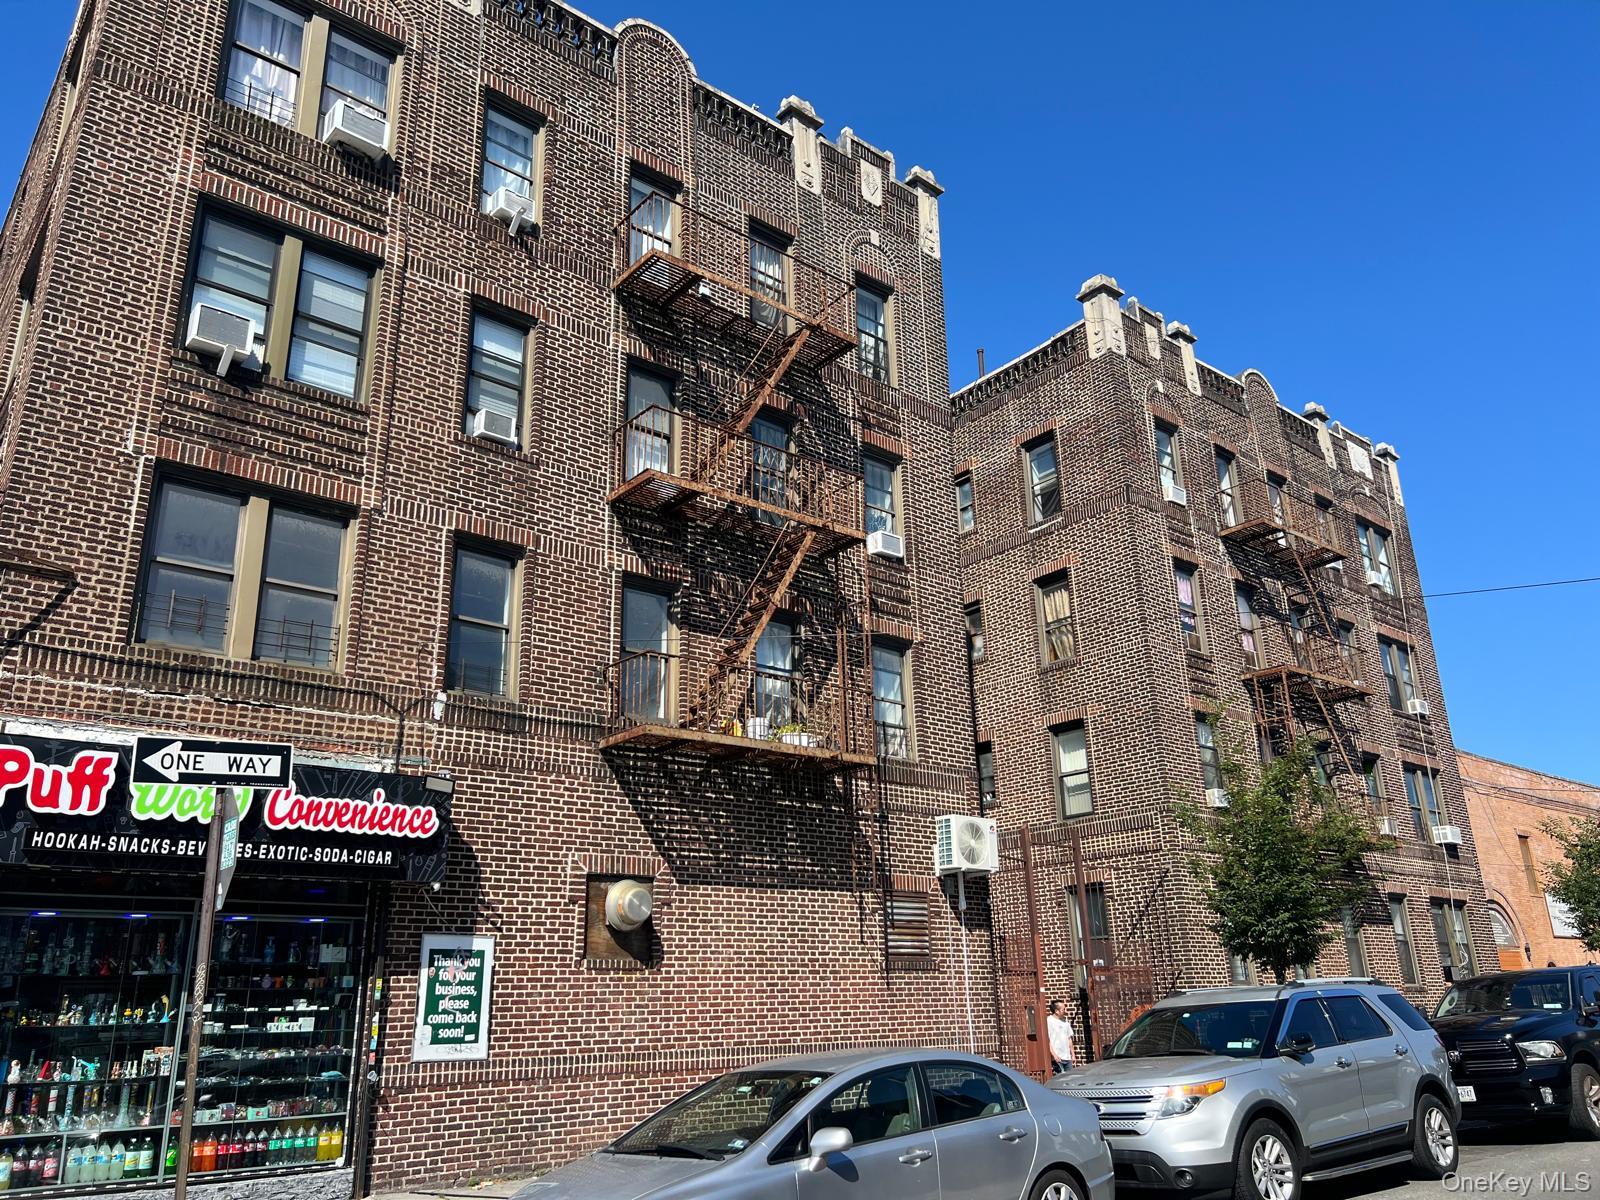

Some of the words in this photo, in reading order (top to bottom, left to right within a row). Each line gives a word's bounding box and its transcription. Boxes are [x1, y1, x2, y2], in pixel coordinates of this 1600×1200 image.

[161, 753, 205, 771] ONE
[228, 756, 272, 774] WAY
[0, 746, 116, 813] Puff
[133, 784, 252, 821] Wor
[265, 787, 437, 836] Convenience
[433, 954, 463, 967] Thank
[464, 957, 481, 970] you
[455, 971, 477, 984] your
[435, 982, 477, 996] business,
[438, 999, 469, 1012] please
[427, 1013, 453, 1024] come
[455, 1011, 477, 1023] back
[438, 1025, 465, 1038] soon!
